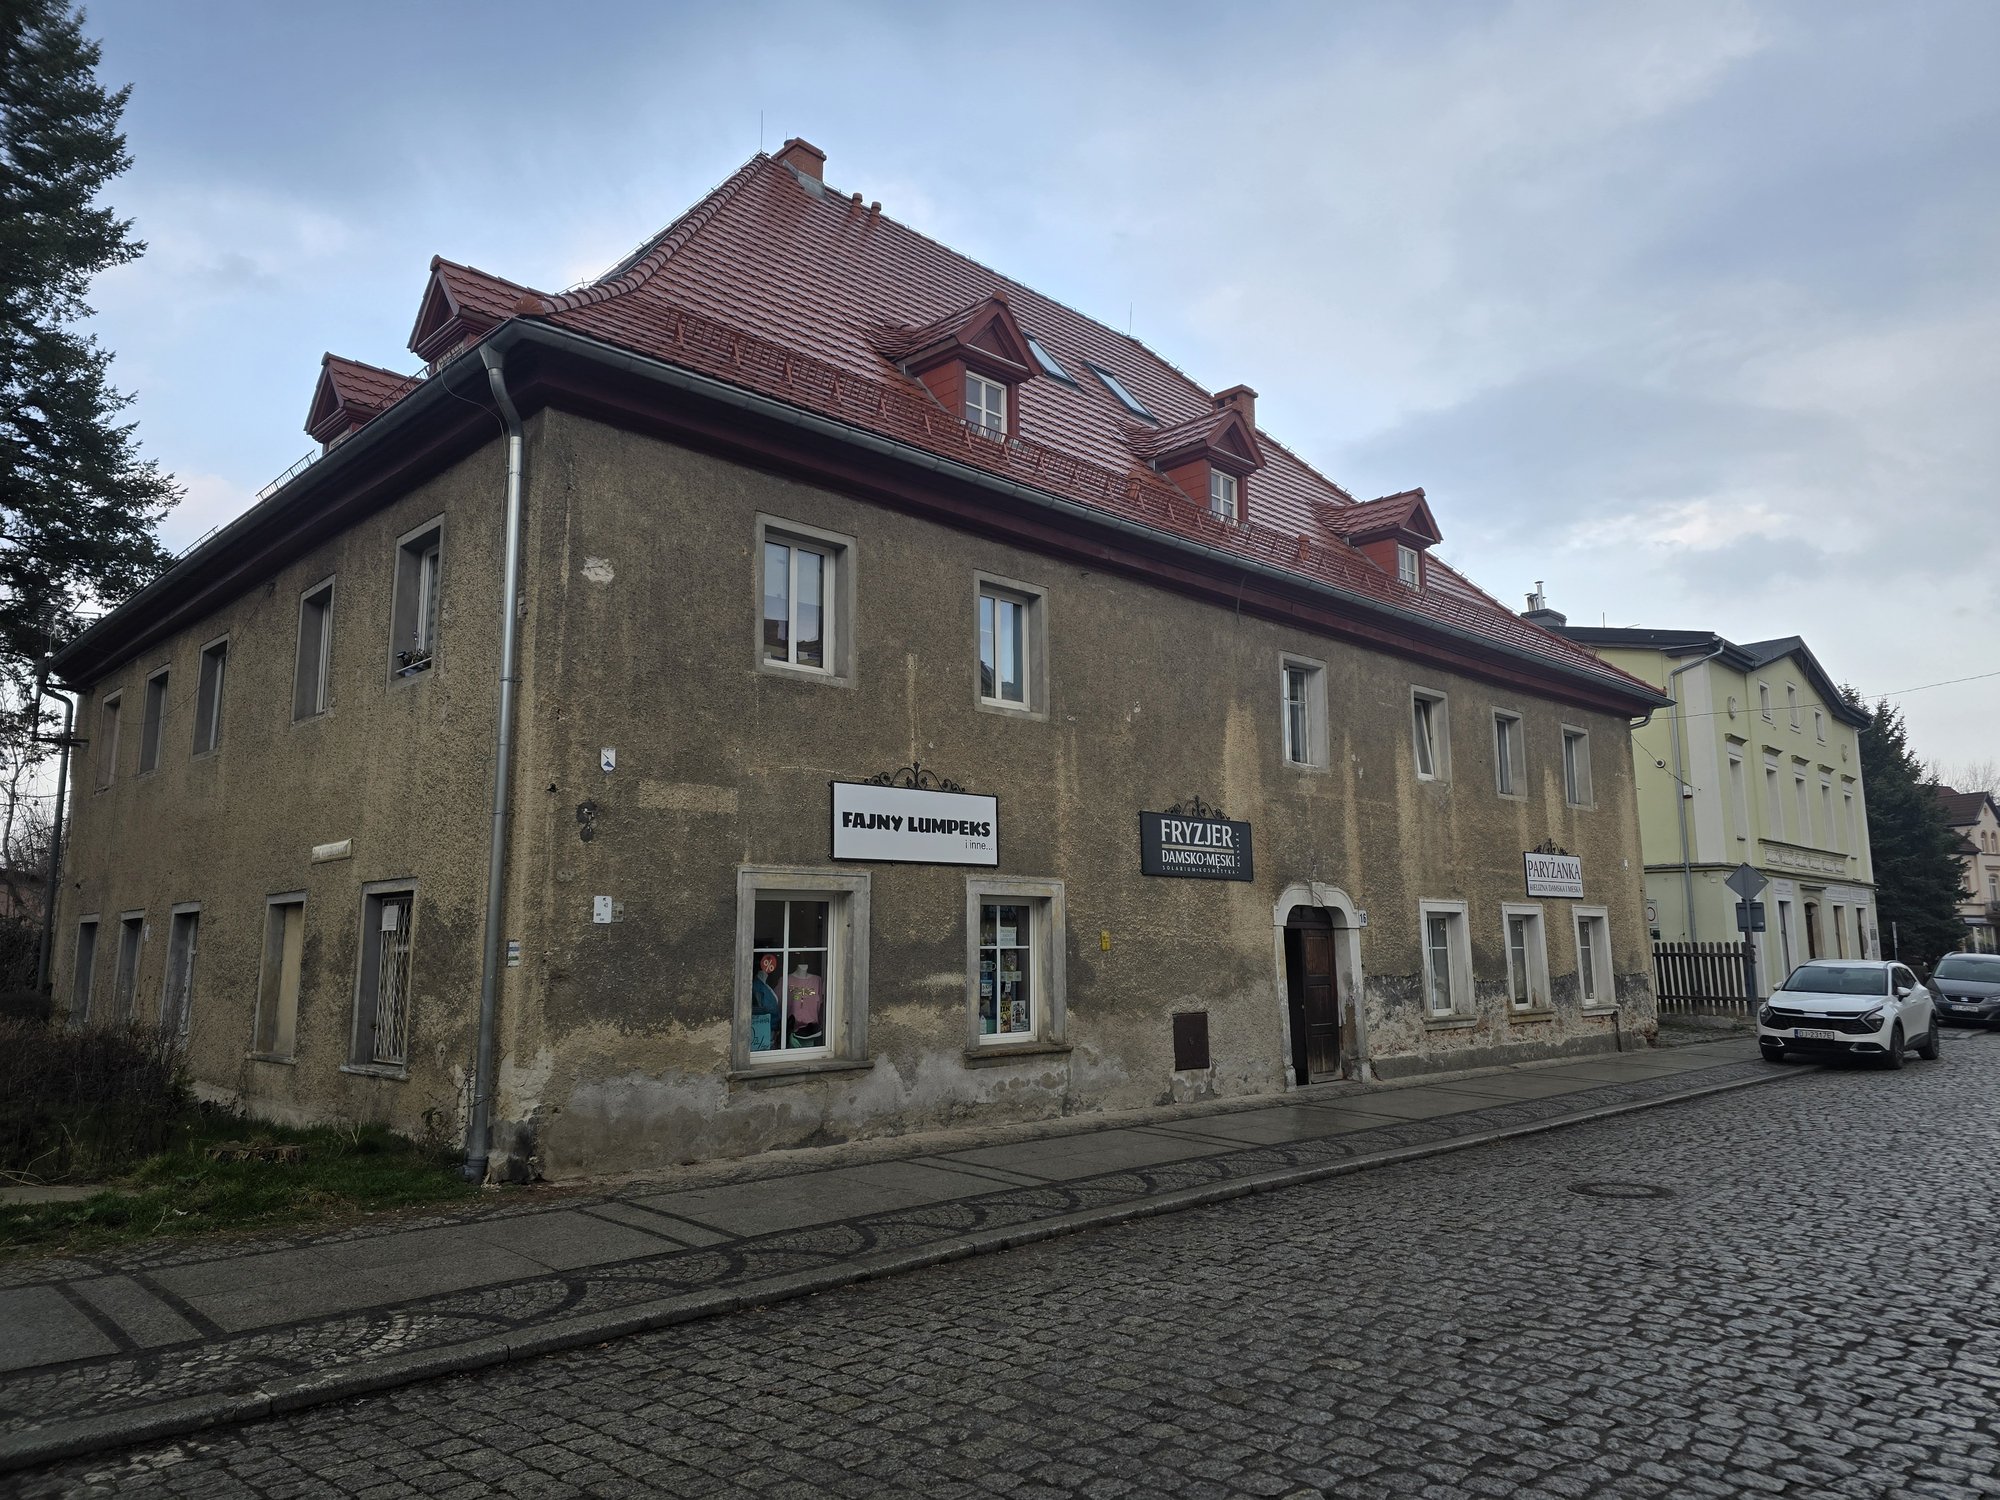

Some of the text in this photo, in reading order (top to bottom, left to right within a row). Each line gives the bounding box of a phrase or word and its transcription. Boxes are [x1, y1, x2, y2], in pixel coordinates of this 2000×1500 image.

[842, 811, 991, 838] FAJNY LUMPEKS
[1160, 819, 1234, 848] FRYZJER
[969, 840, 993, 851] inne...
[1162, 849, 1235, 870] DAMSKO-MĘSKI
[1527, 857, 1581, 880] PARYŻANKA
[1359, 913, 1367, 923] 16
